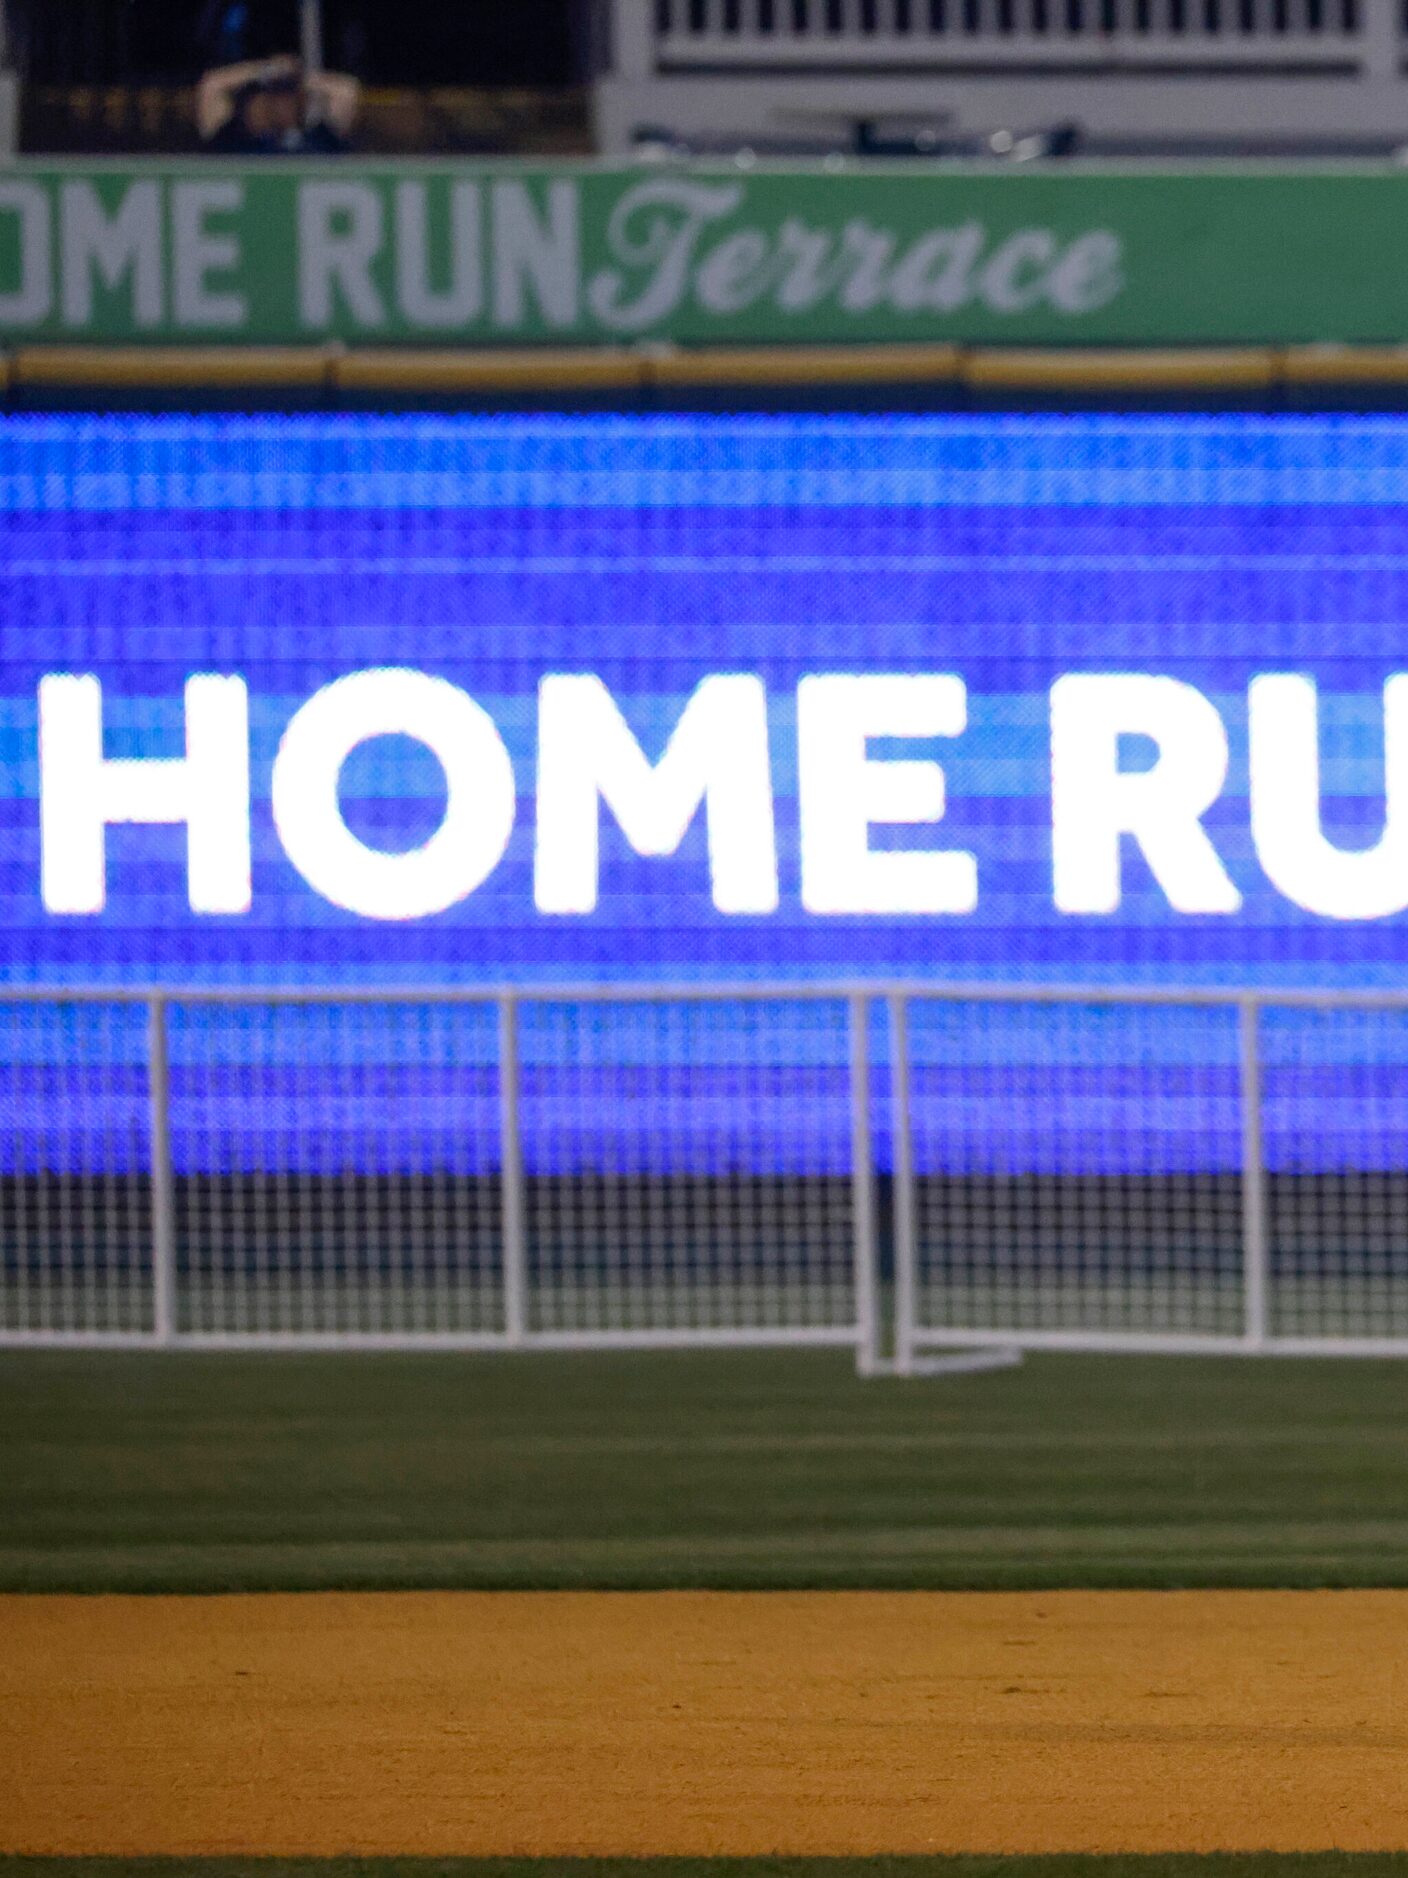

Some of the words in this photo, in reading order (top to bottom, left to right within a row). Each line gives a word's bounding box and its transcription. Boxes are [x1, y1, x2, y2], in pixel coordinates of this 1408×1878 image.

[298, 178, 580, 329] RUN
[585, 177, 1126, 332] Terrace
[39, 668, 978, 919] HOME
